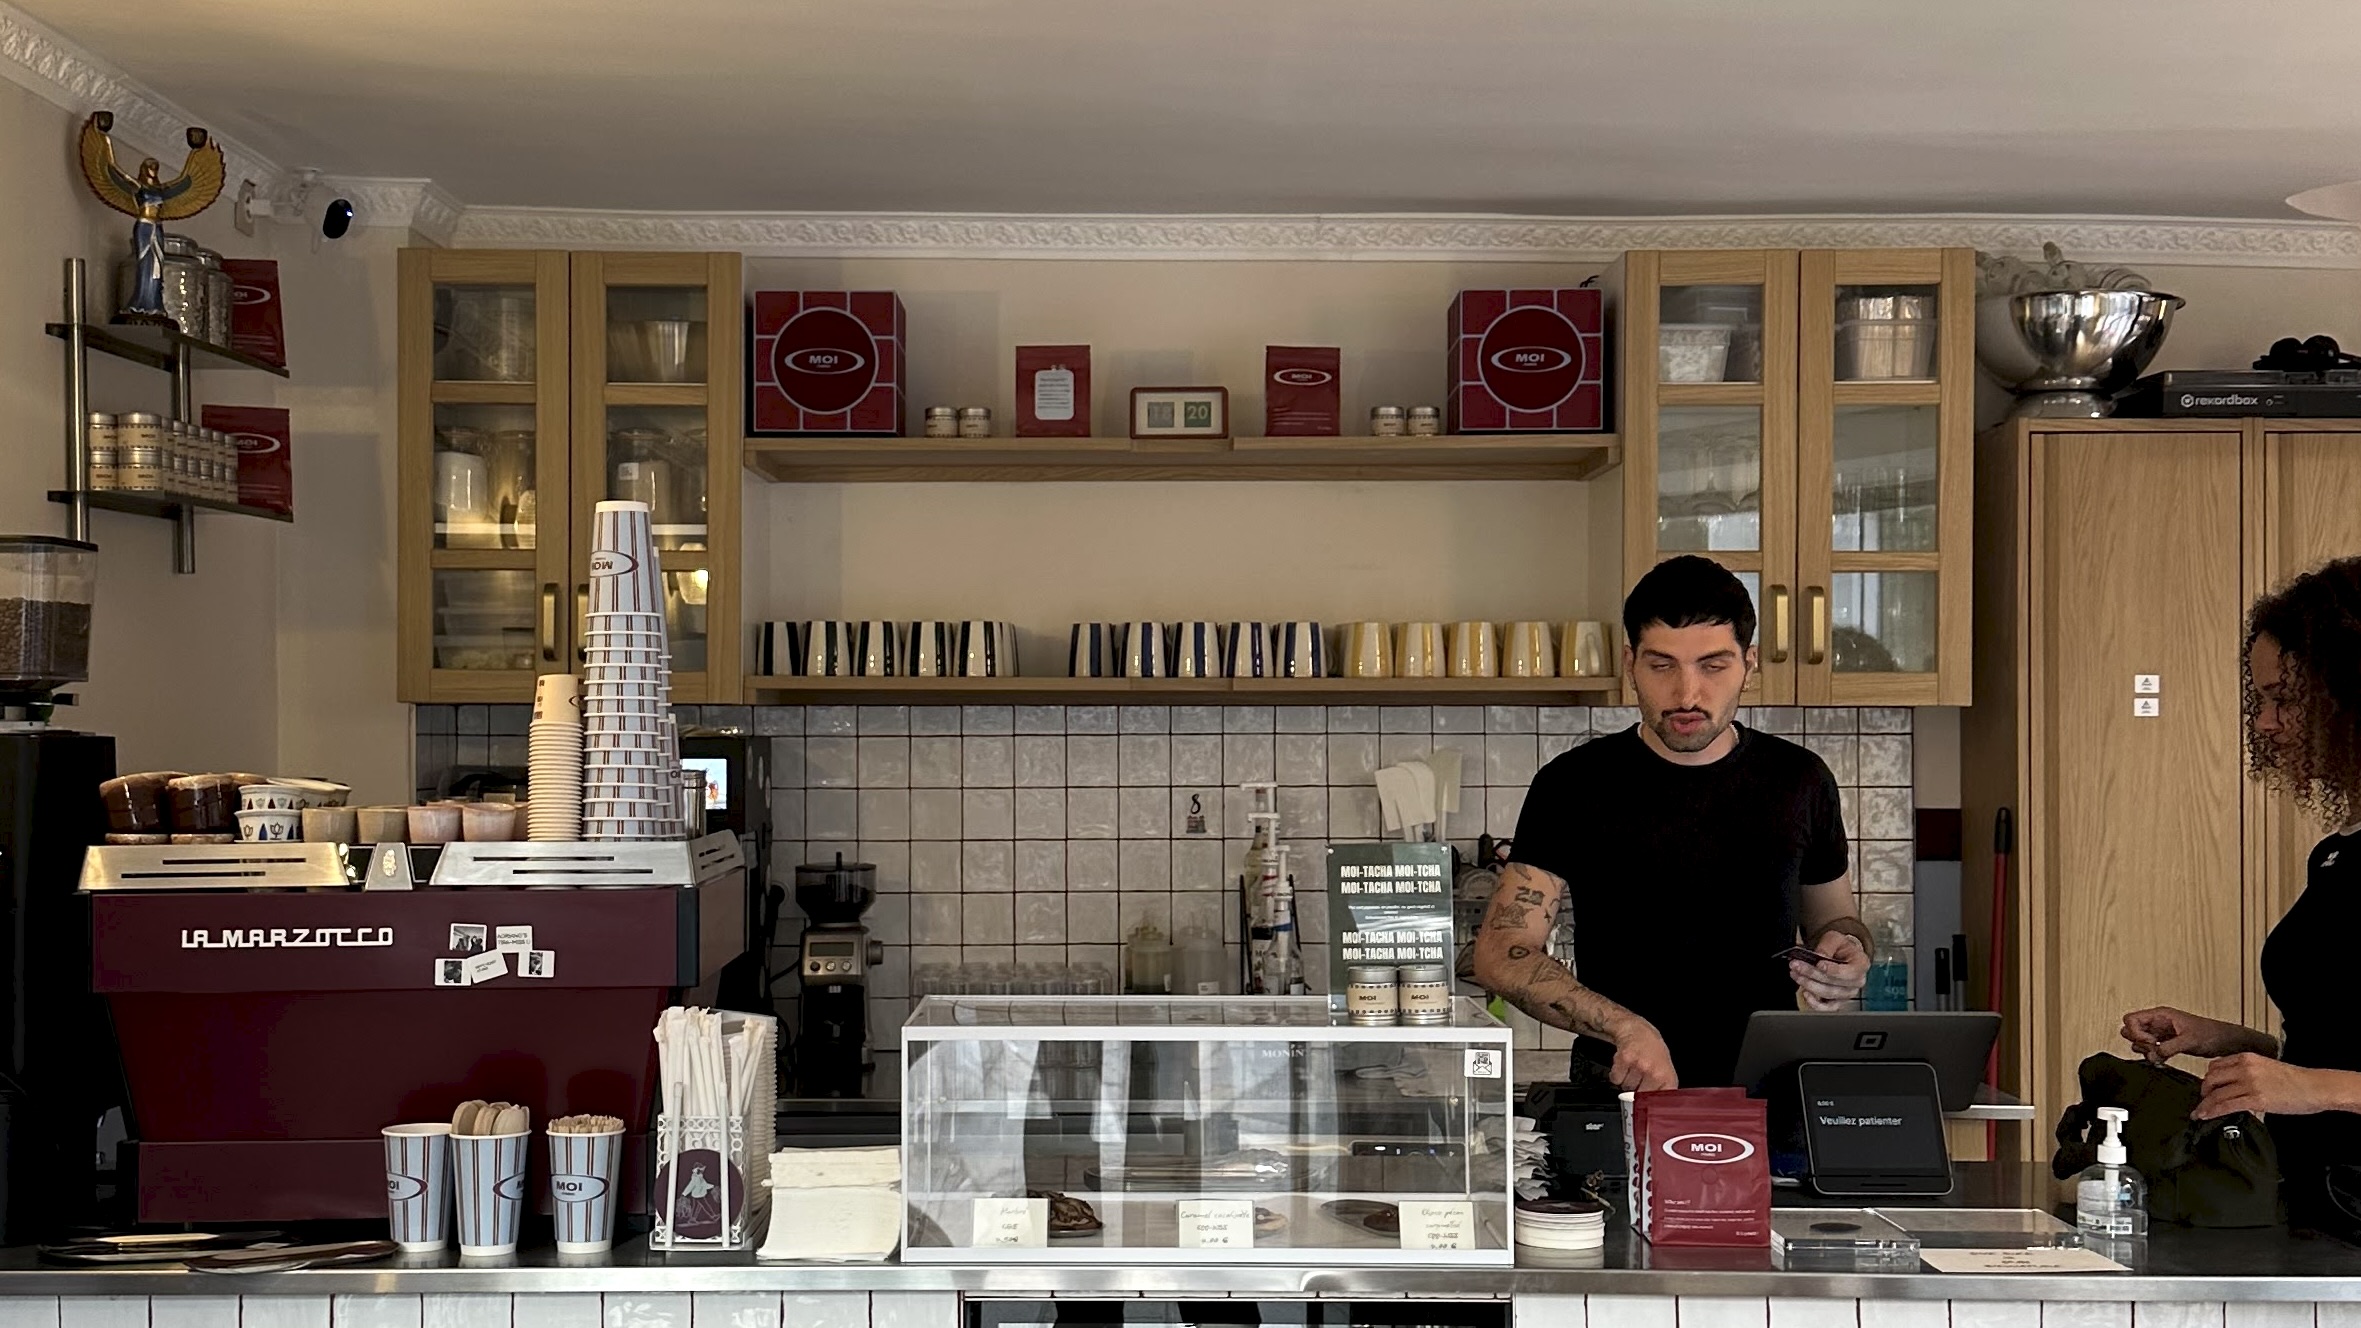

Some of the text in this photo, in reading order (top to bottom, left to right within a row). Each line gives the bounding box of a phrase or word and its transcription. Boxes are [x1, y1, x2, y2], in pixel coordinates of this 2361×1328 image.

[809, 355, 838, 364] MOI
[1515, 353, 1545, 362] MOI
[2195, 394, 2258, 405] rekordbox
[1187, 405, 1209, 420] 20
[1341, 865, 1441, 877] MOI-TACHA MOI-TCHA
[1341, 881, 1442, 894] MOI-TACHA MOI-TCHA
[181, 929, 208, 948] LA
[1342, 931, 1443, 944] MOI-TACHA MOI-TCHA
[1342, 947, 1444, 960] MOI-TACHA MOI-TCHA
[1262, 1049, 1304, 1058] MONIN
[1819, 1116, 1902, 1127] Veuillez patienter
[1691, 1143, 1722, 1152] MOI
[387, 1181, 400, 1190] OI
[556, 1181, 583, 1192] MOI
